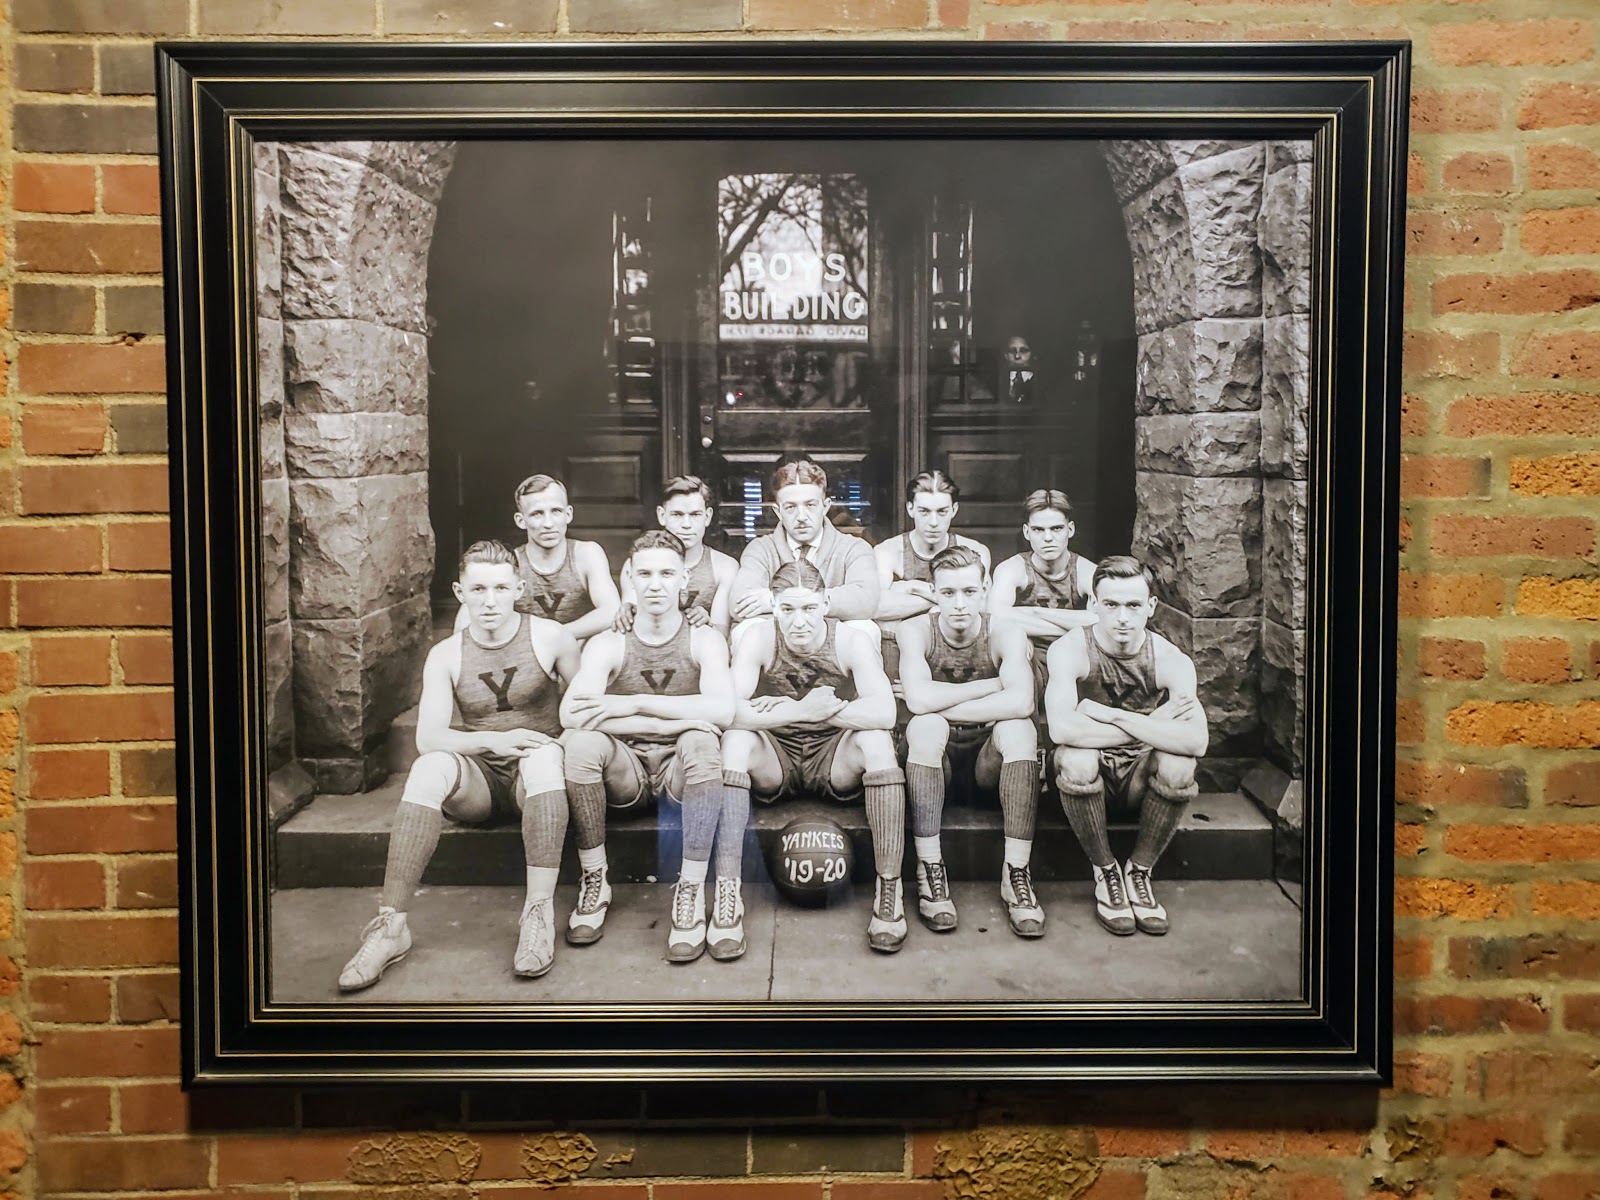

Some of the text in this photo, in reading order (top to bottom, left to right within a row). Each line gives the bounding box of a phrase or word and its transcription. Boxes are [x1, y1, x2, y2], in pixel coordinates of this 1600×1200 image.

[724, 291, 865, 320] BUILDING
[478, 666, 518, 712] Y
[782, 831, 844, 852] YANKEES
[785, 857, 847, 883] '19-20
